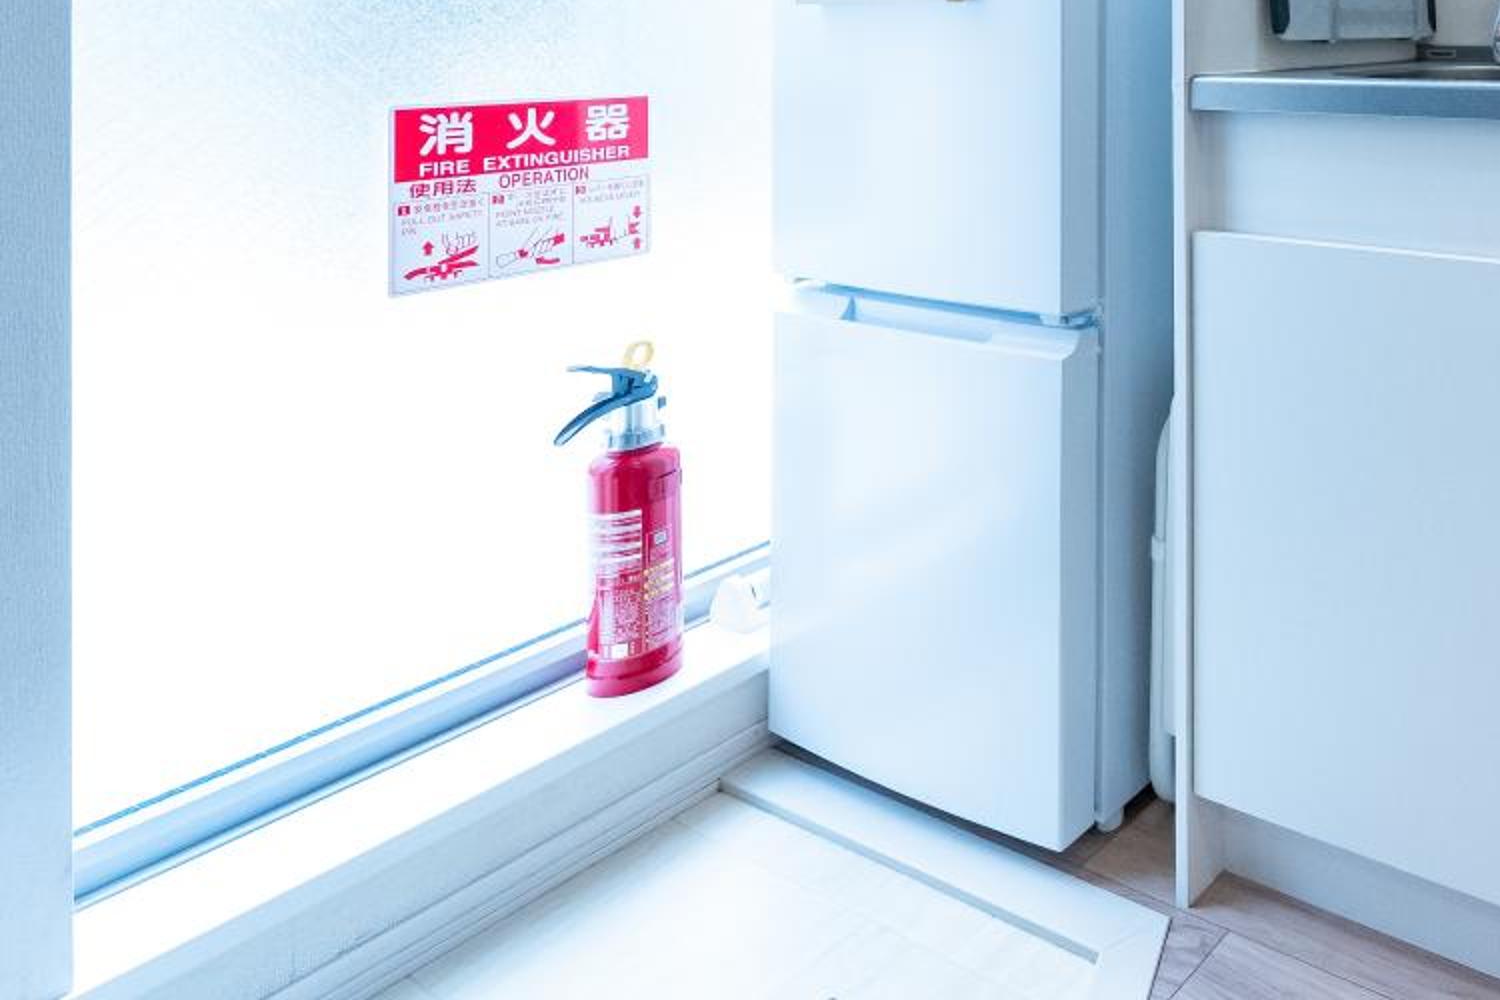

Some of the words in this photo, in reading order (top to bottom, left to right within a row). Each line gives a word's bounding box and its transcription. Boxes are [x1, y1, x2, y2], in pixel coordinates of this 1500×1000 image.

[419, 159, 471, 177] FIRE
[483, 145, 630, 172] EXTINGUISHER
[409, 178, 478, 199] 使用法
[498, 166, 590, 189] OPERATION
